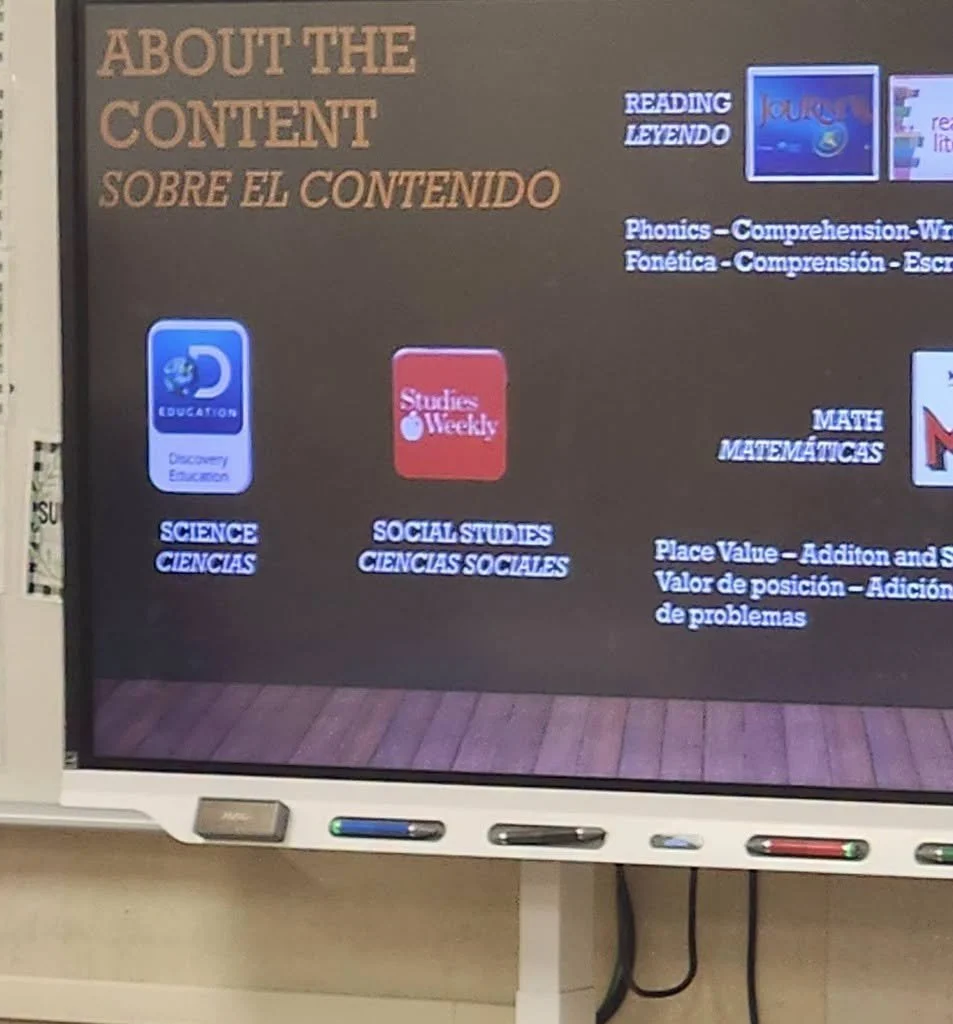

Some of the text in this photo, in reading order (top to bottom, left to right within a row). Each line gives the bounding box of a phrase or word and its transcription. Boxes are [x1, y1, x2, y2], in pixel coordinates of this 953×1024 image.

[96, 25, 417, 76] ABOUT THE
[624, 92, 732, 115] READING
[99, 98, 378, 149] CONTENT
[624, 124, 732, 147] LEYENDO
[934, 133, 953, 152] lit
[99, 170, 561, 209] SOBRE EL CONTENIDO
[625, 217, 712, 240] Phonics
[625, 249, 717, 273] Fonética
[734, 250, 886, 277] Comprensión
[400, 388, 479, 411] Studies
[159, 406, 237, 418] EDUCATION
[813, 409, 884, 432] MATH
[424, 413, 499, 442] Weekly
[169, 453, 228, 468] Discovery
[718, 436, 884, 464] MATEMÁTICAS
[169, 469, 229, 483] Education
[160, 521, 259, 545] SCIENCE
[373, 521, 552, 546] SOCIAL STUDIES
[155, 552, 257, 575] CIENCIAS
[359, 551, 570, 578] CIENCIAS SOCIALES
[654, 539, 715, 562] Place
[717, 541, 779, 564] Value
[799, 543, 891, 566] Additon
[894, 546, 938, 567] and
[654, 570, 714, 593] Valor
[717, 572, 747, 594] de
[750, 574, 846, 600] posición
[655, 602, 807, 629] de problemas
